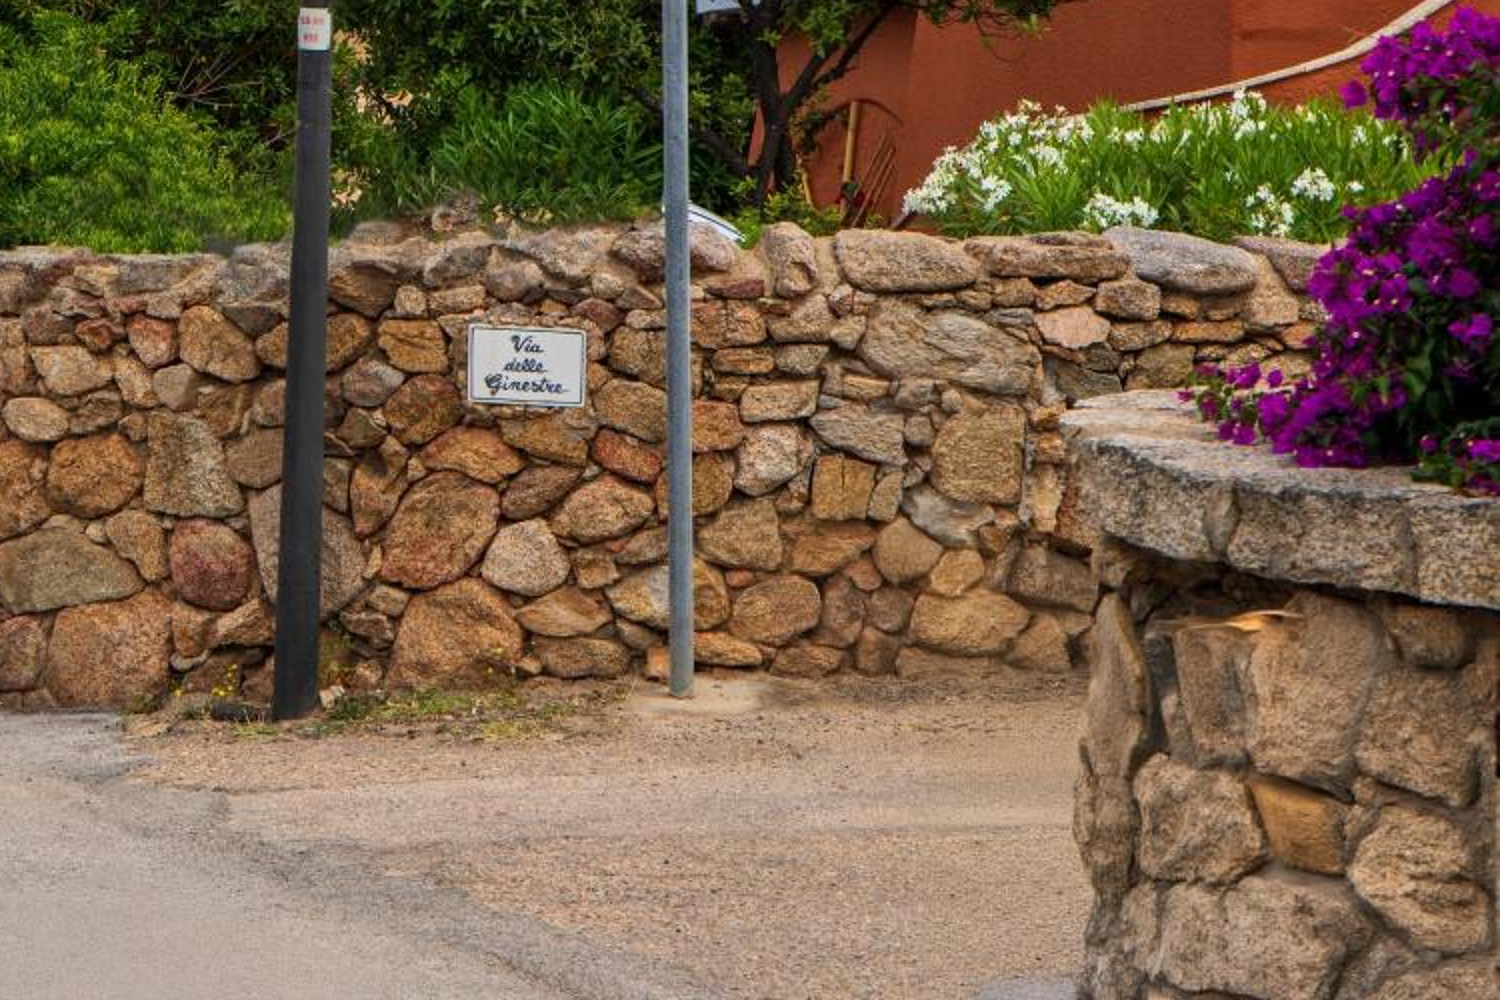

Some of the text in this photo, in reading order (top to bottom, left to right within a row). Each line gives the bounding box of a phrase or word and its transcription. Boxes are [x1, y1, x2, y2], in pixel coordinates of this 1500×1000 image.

[510, 335, 544, 353] Via
[503, 358, 548, 373] delle
[484, 374, 570, 396] Ginestre
